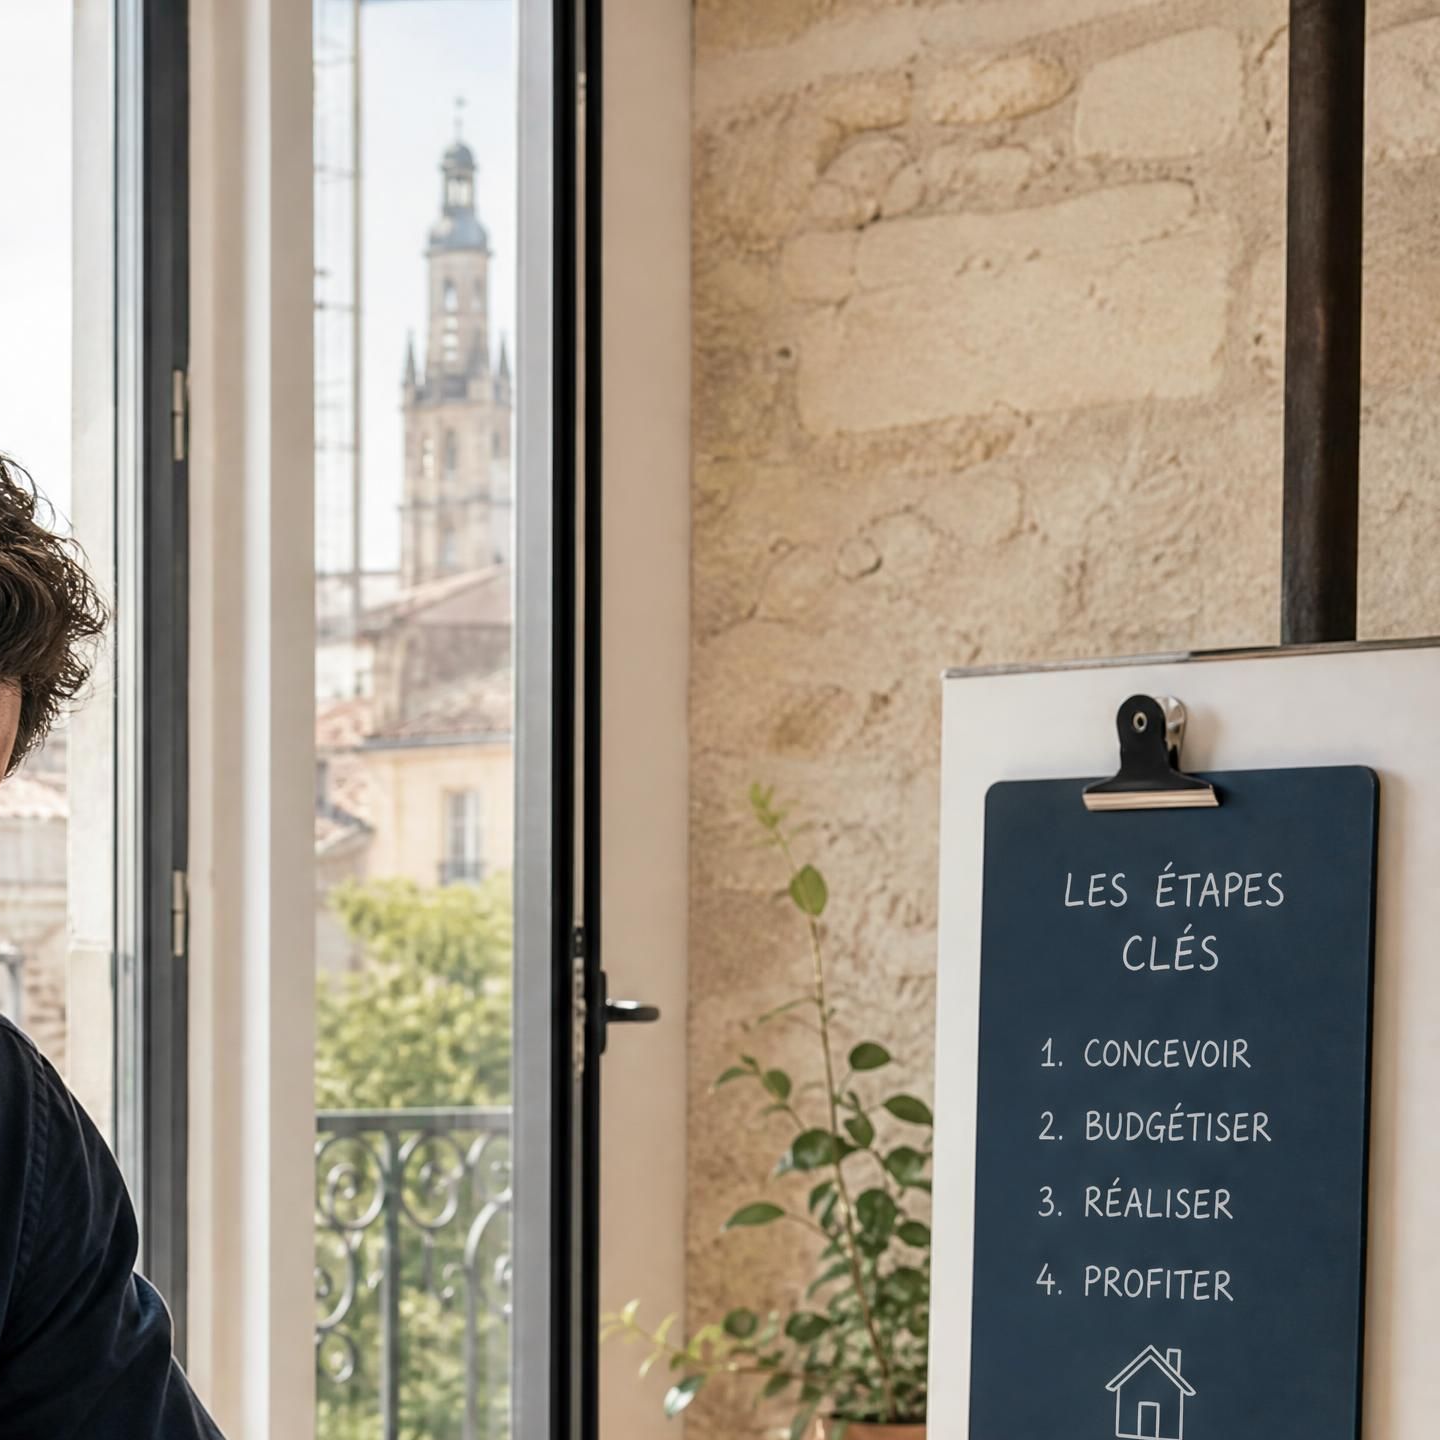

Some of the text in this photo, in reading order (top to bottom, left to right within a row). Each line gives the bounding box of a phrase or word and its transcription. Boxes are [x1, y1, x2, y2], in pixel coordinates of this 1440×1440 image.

[1064, 861, 1285, 908] LES ÉTAPES
[1122, 923, 1219, 972] CLÉS
[1041, 1037, 1252, 1069] 1. CONCEVOIR
[1038, 1102, 1272, 1144] 2. BUDGÉTISER
[1038, 1176, 1234, 1220] 3. RÉALISER
[1035, 1263, 1234, 1302] 4. PROFITER
